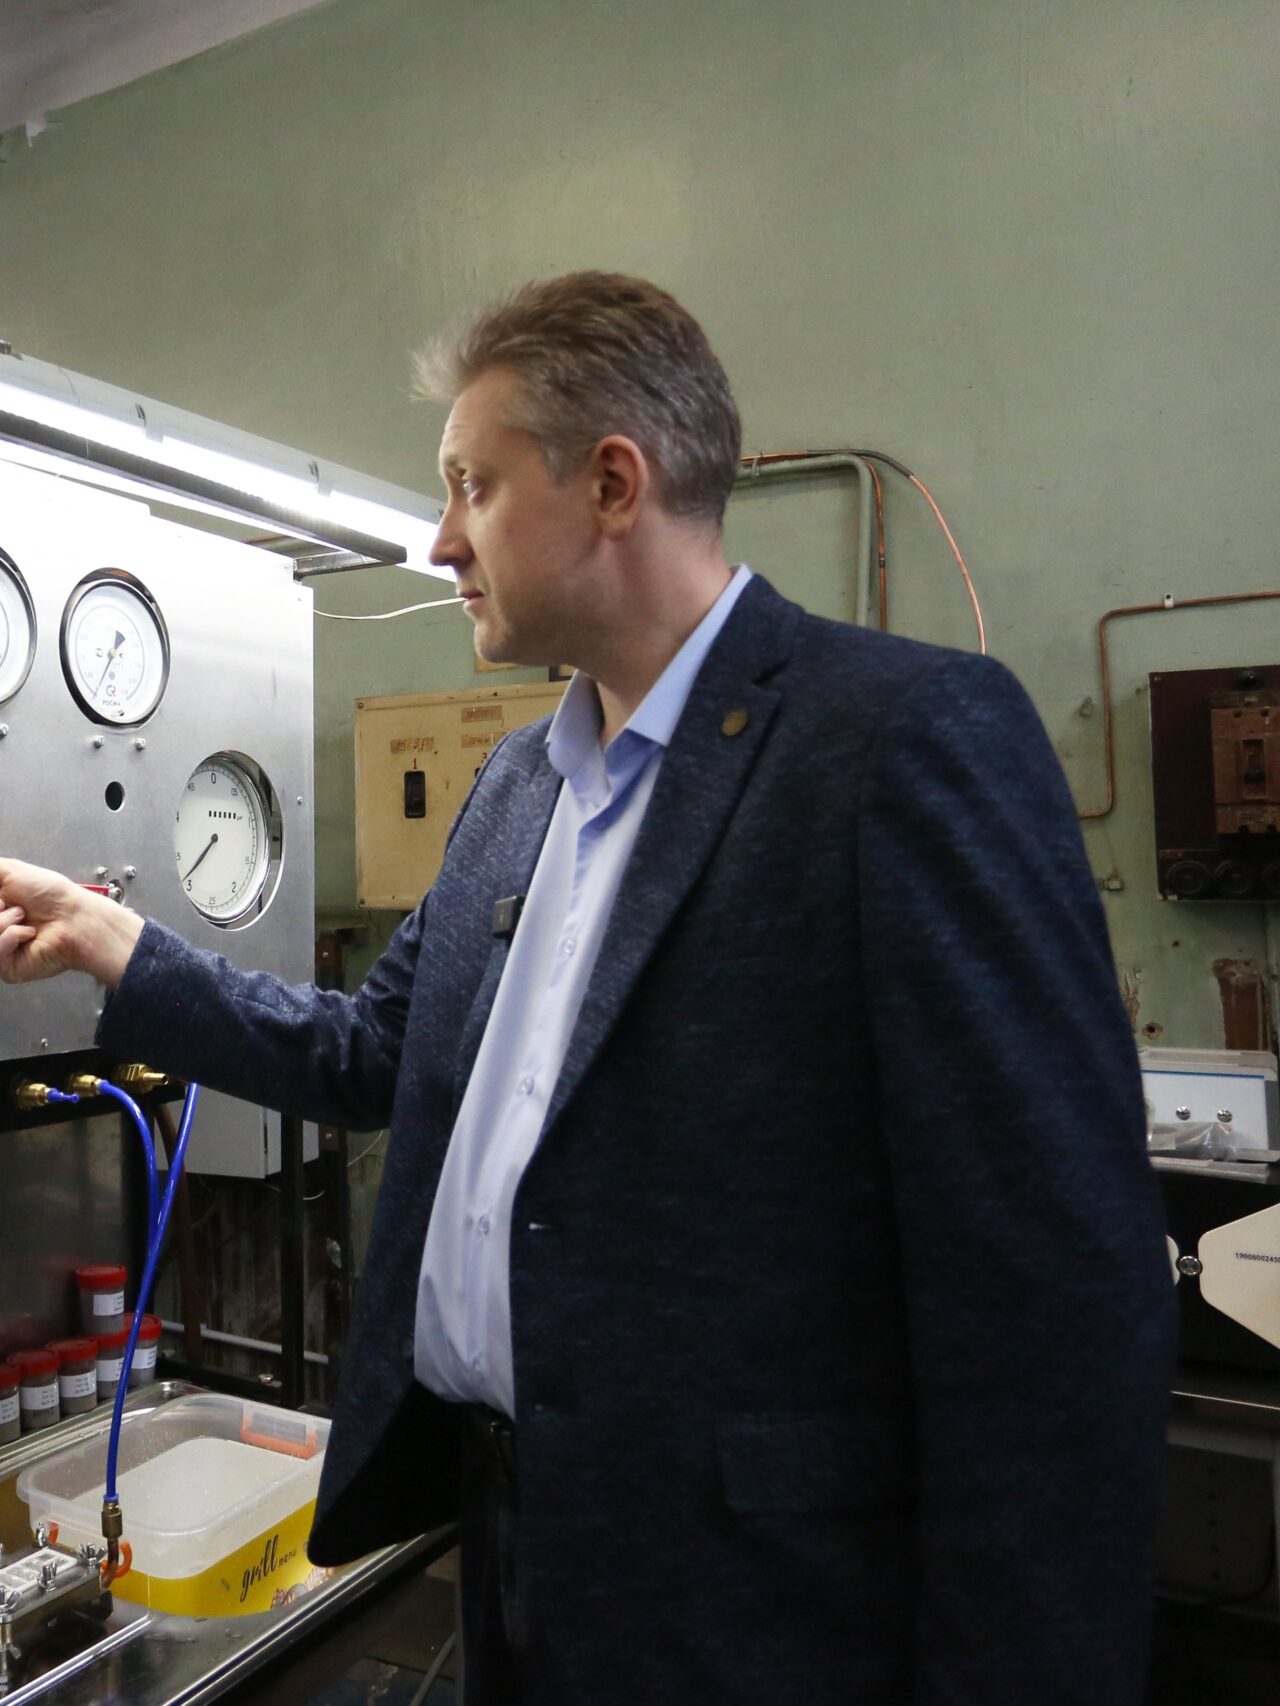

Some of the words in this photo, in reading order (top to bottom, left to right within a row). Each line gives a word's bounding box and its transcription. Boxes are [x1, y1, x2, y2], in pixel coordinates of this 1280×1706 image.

[211, 772, 217, 784] 0
[186, 879, 192, 892] 3
[231, 881, 237, 893] 2
[240, 1534, 279, 1603] grill
